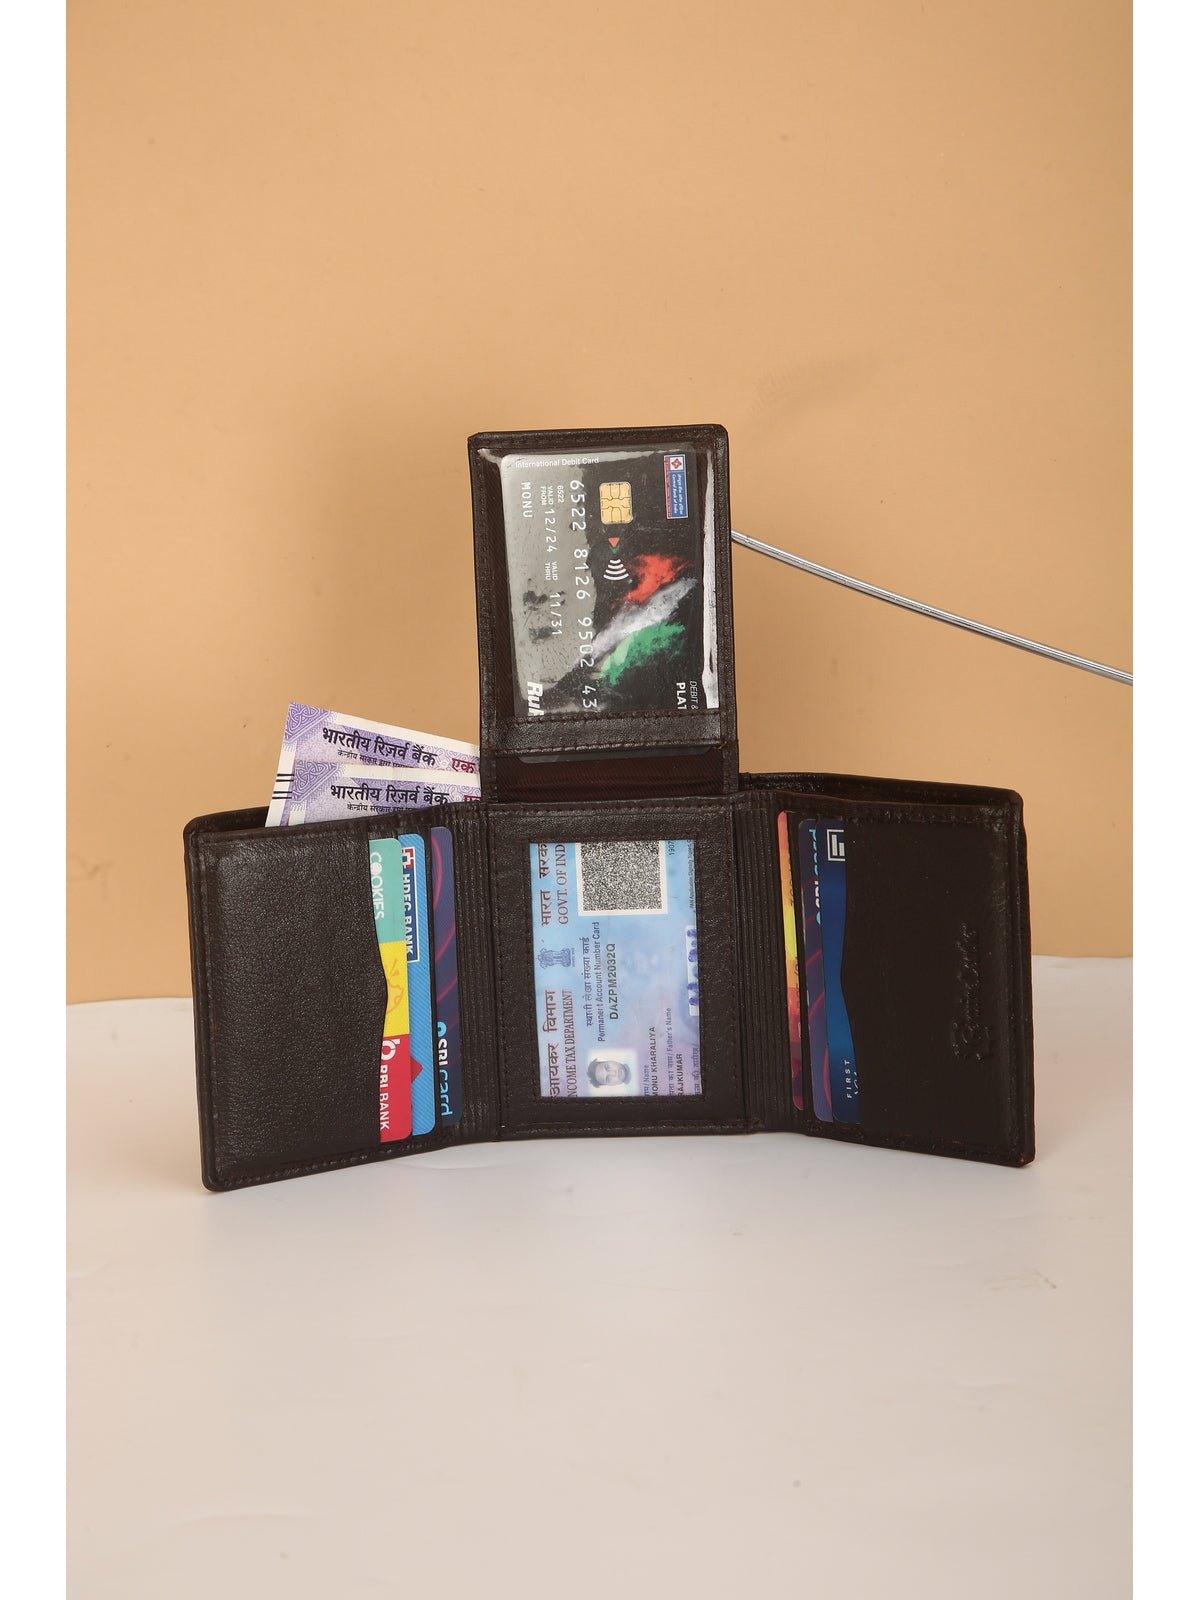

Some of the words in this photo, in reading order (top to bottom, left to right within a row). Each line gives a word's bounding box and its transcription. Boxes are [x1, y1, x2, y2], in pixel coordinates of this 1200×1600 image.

[515, 459, 560, 468] International
[562, 458, 581, 466] Debit
[582, 457, 599, 466] Card
[520, 482, 533, 518] MONU
[570, 480, 587, 531] 6522
[546, 508, 558, 553] 12/24
[574, 548, 591, 600] 8126
[550, 591, 563, 636] 11/31
[577, 617, 595, 668] 9502
[690, 681, 698, 704] DEBIT
[322, 727, 371, 750] भारतीय
[412, 745, 438, 767] बैंक
[452, 758, 475, 773] एक
[331, 783, 382, 801] भारतीय
[423, 786, 449, 804] बैंक
[556, 869, 567, 886] OF
[540, 889, 552, 927] भारत
[557, 889, 569, 925] GOVT.
[405, 916, 414, 955] BANK
[591, 922, 600, 940] Card
[594, 941, 602, 970] Number
[595, 971, 604, 1002] Account
[607, 943, 619, 1020] DAZPM2032Q
[542, 990, 558, 1032] विभाग
[562, 990, 575, 1045] DEPARTMENT
[564, 1047, 576, 1064] TAX
[649, 1026, 657, 1073] KHARALIYA
[547, 1043, 560, 1096] आयकर
[843, 1059, 852, 1099] FIRST
[380, 1093, 390, 1131] BANK
